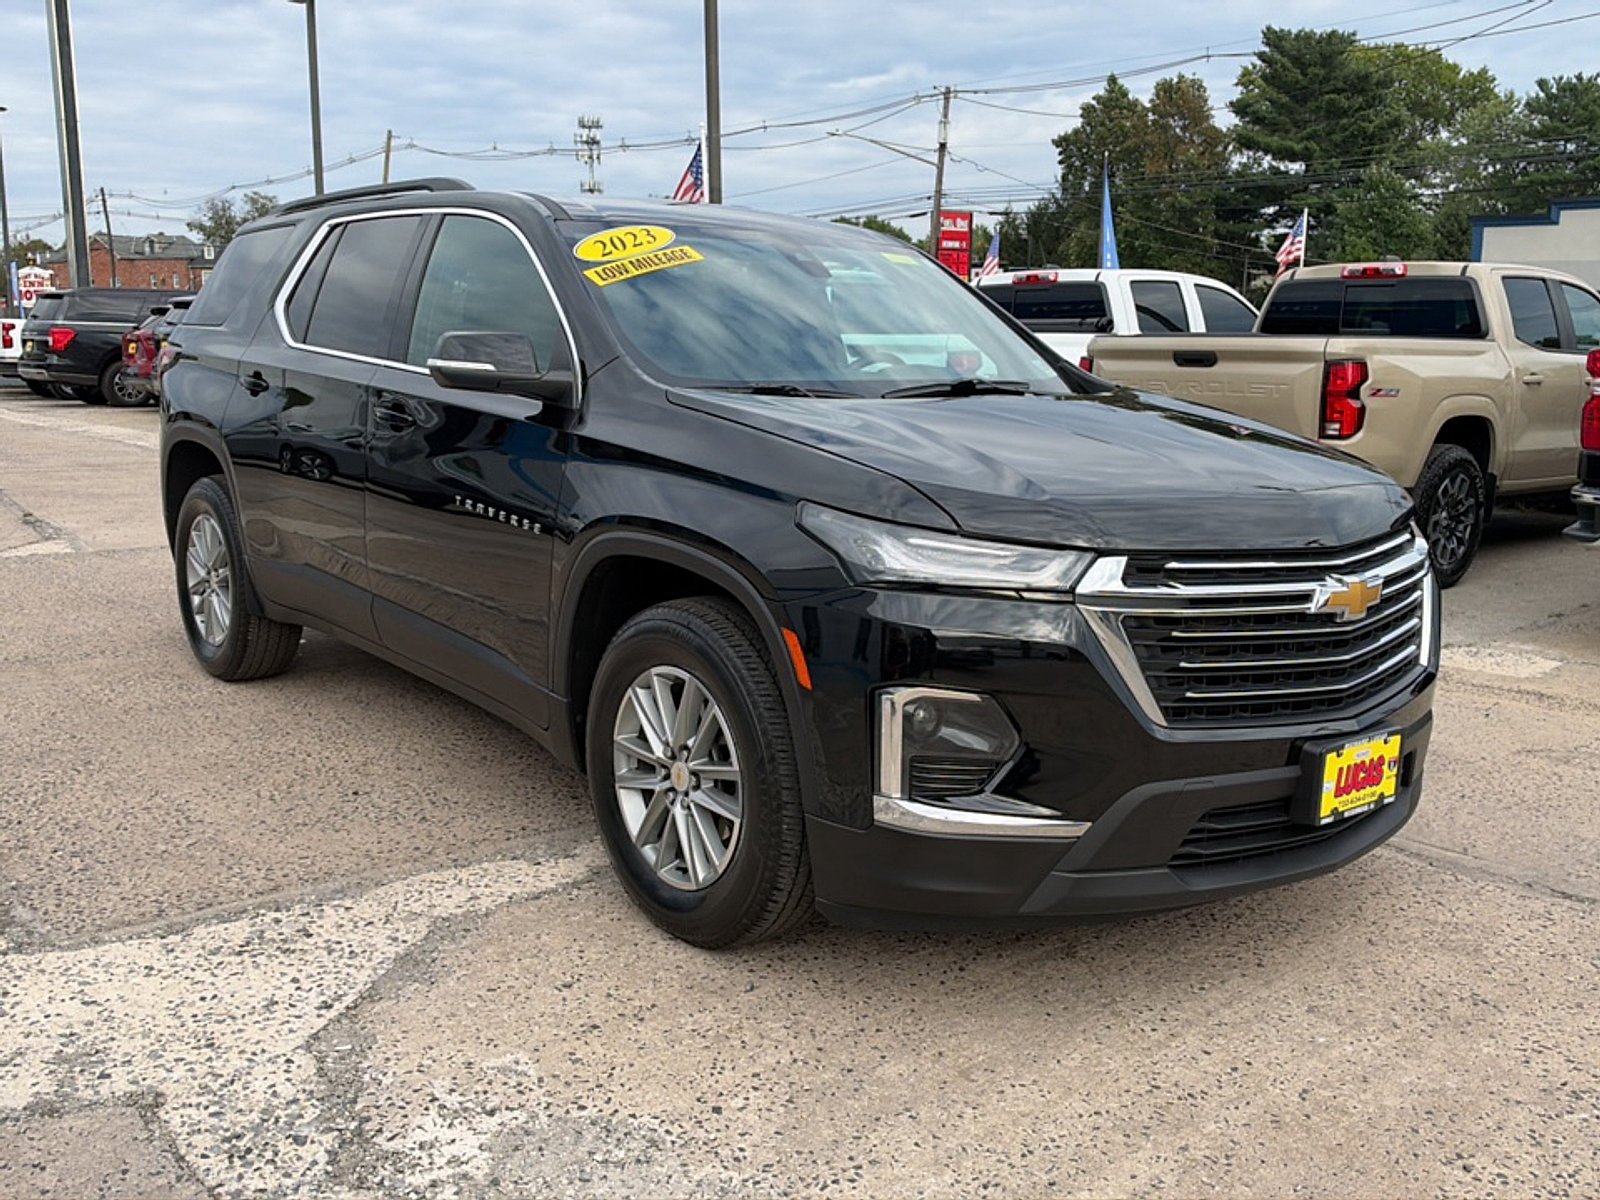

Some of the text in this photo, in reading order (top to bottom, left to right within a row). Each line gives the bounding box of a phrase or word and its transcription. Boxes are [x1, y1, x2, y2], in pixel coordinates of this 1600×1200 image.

[593, 228, 658, 258] 2023
[594, 248, 694, 281] LOW MILEAGE
[455, 495, 542, 535] TRAVERSE
[1333, 754, 1386, 799] LUCAS
